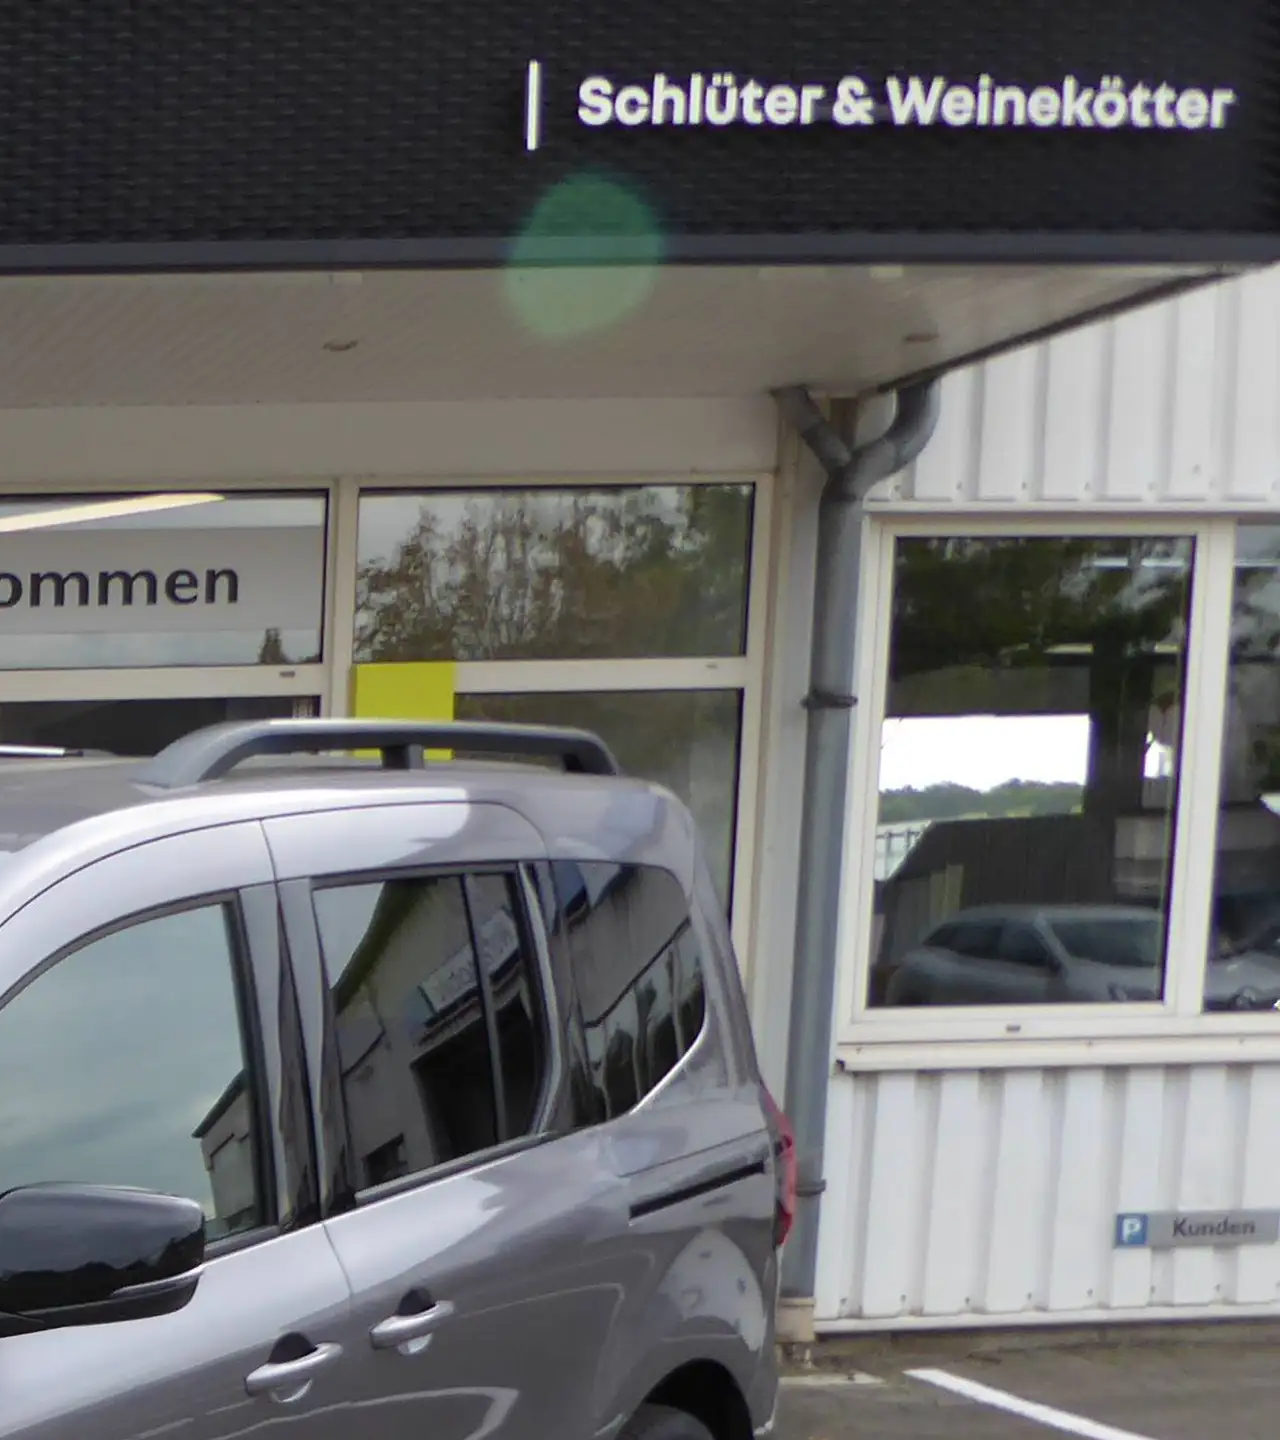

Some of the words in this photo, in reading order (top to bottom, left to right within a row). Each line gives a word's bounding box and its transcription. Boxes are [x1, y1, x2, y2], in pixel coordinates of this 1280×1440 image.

[577, 72, 826, 126] Schlüter
[831, 76, 876, 126] &
[885, 75, 1235, 129] Weinekötter
[1172, 1217, 1256, 1237] Kunden
